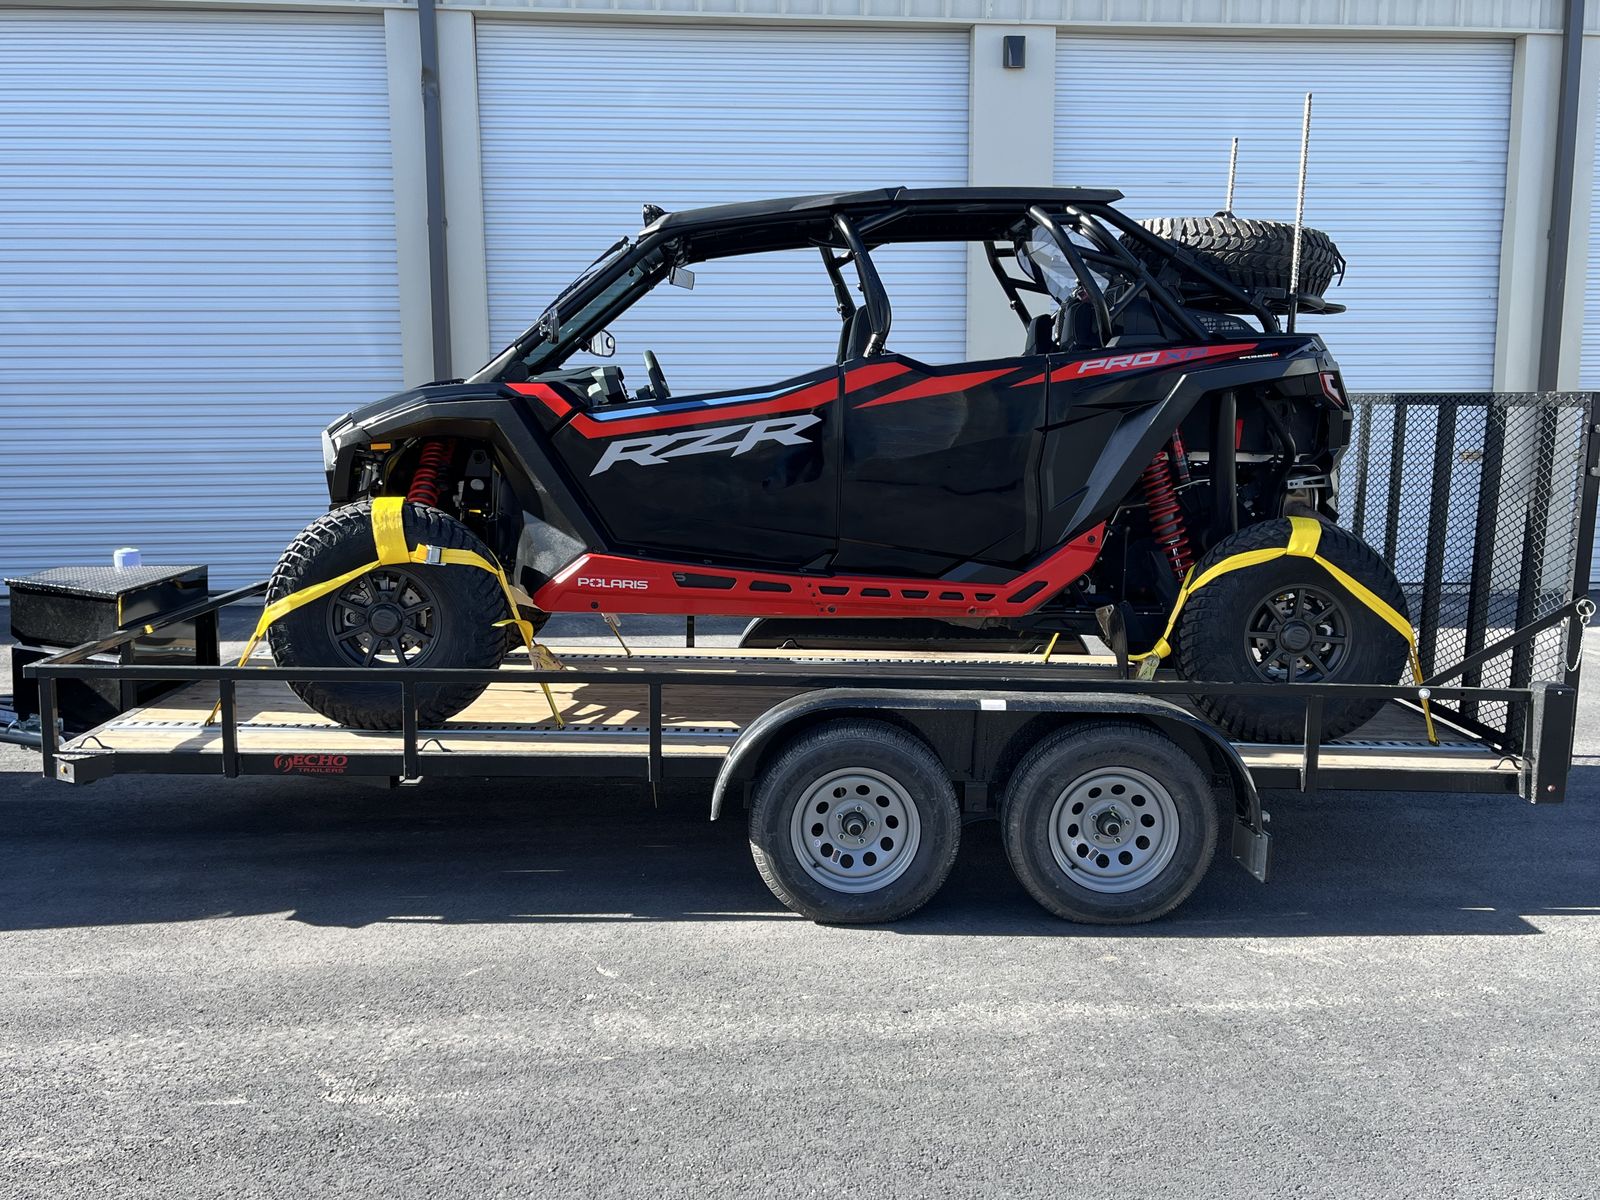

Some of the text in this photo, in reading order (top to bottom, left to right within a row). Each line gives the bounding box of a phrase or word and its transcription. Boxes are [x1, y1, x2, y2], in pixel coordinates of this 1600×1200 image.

[1077, 352, 1161, 374] PRO
[589, 413, 822, 477] RZR
[577, 577, 649, 590] POLARIS
[292, 754, 348, 766] ECHO
